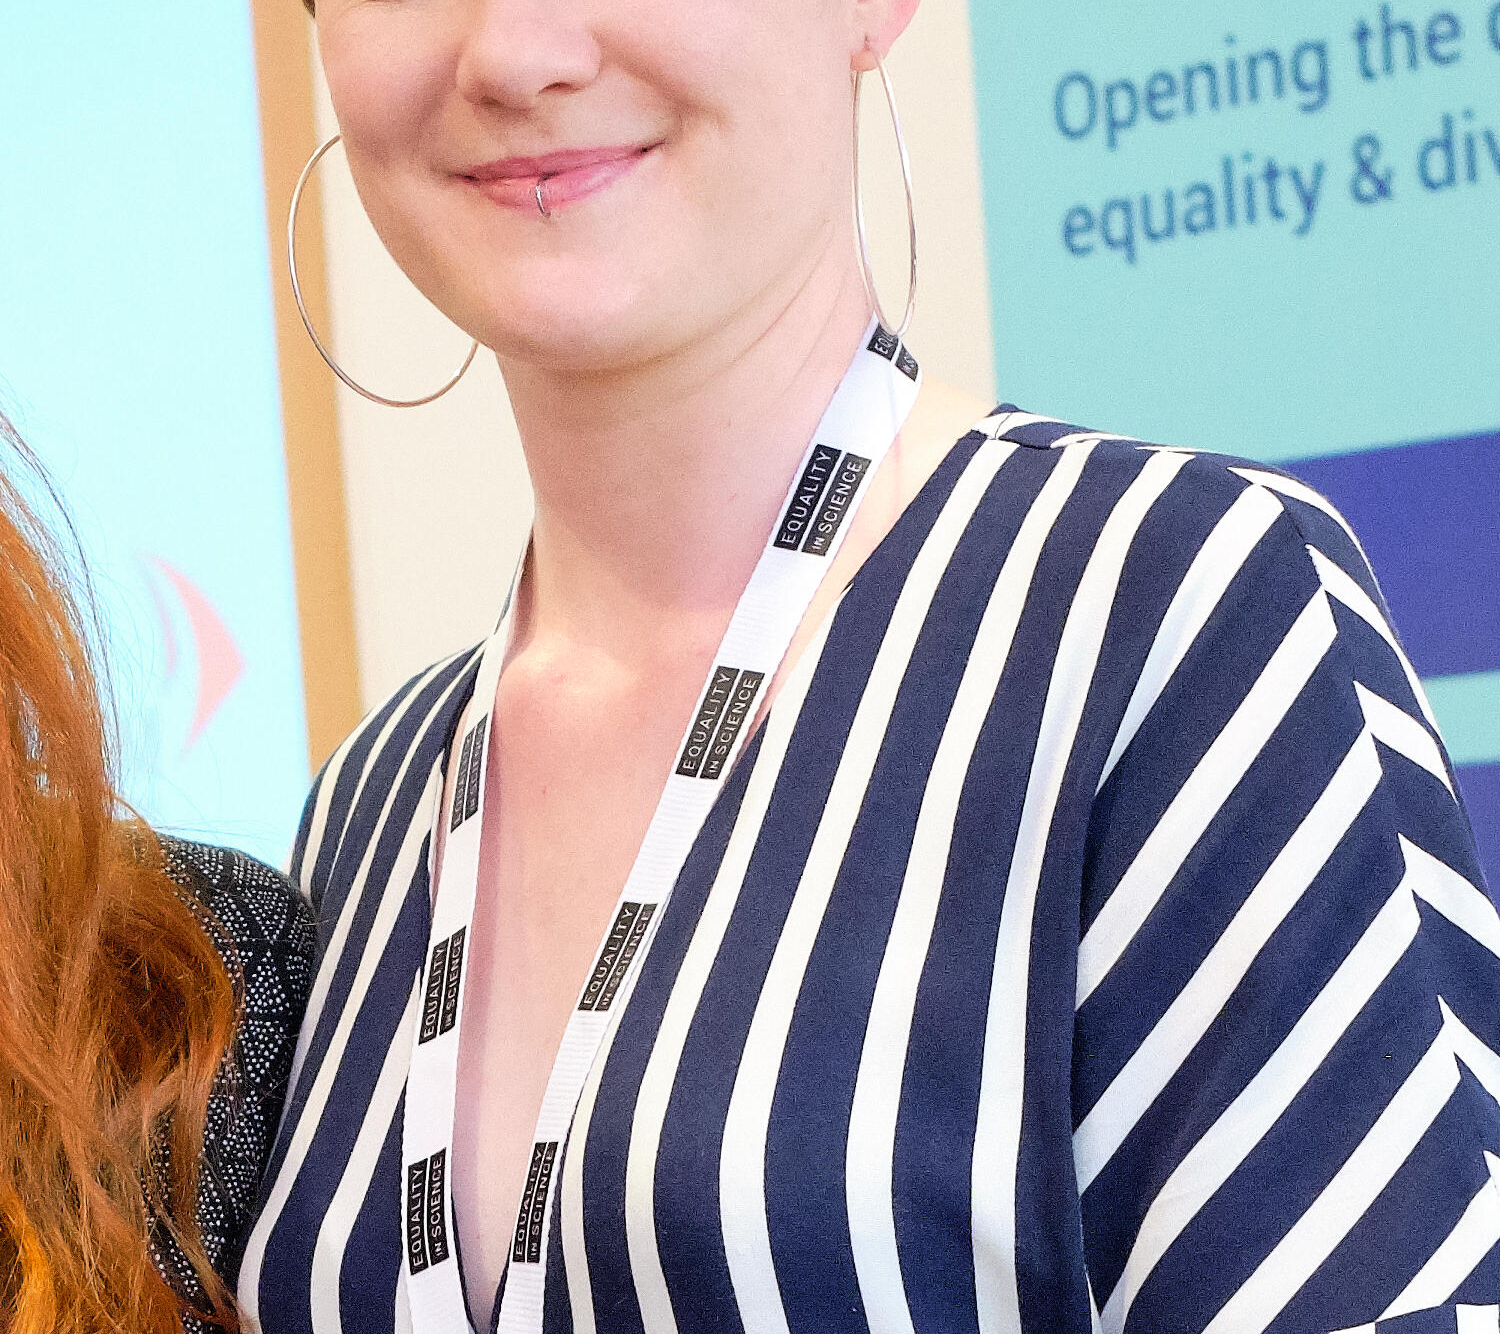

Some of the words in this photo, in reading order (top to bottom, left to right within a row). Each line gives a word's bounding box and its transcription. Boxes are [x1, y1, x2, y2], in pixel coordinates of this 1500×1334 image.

[1053, 34, 1330, 151] Opening
[1355, 1, 1462, 82] the
[1060, 151, 1324, 265] equality
[1350, 132, 1394, 206] &
[780, 450, 831, 544] EQUALITY
[812, 537, 825, 550] IN
[818, 461, 862, 534] SCIENCE
[682, 673, 731, 770] EQUALITY
[709, 760, 719, 773] IN
[715, 678, 758, 755] SCIENCE
[424, 949, 444, 1038] EQUALITY
[584, 908, 633, 1004] EQUALITY
[411, 1169, 423, 1267] EQUALITY
[431, 1157, 442, 1238] SCIENCE
